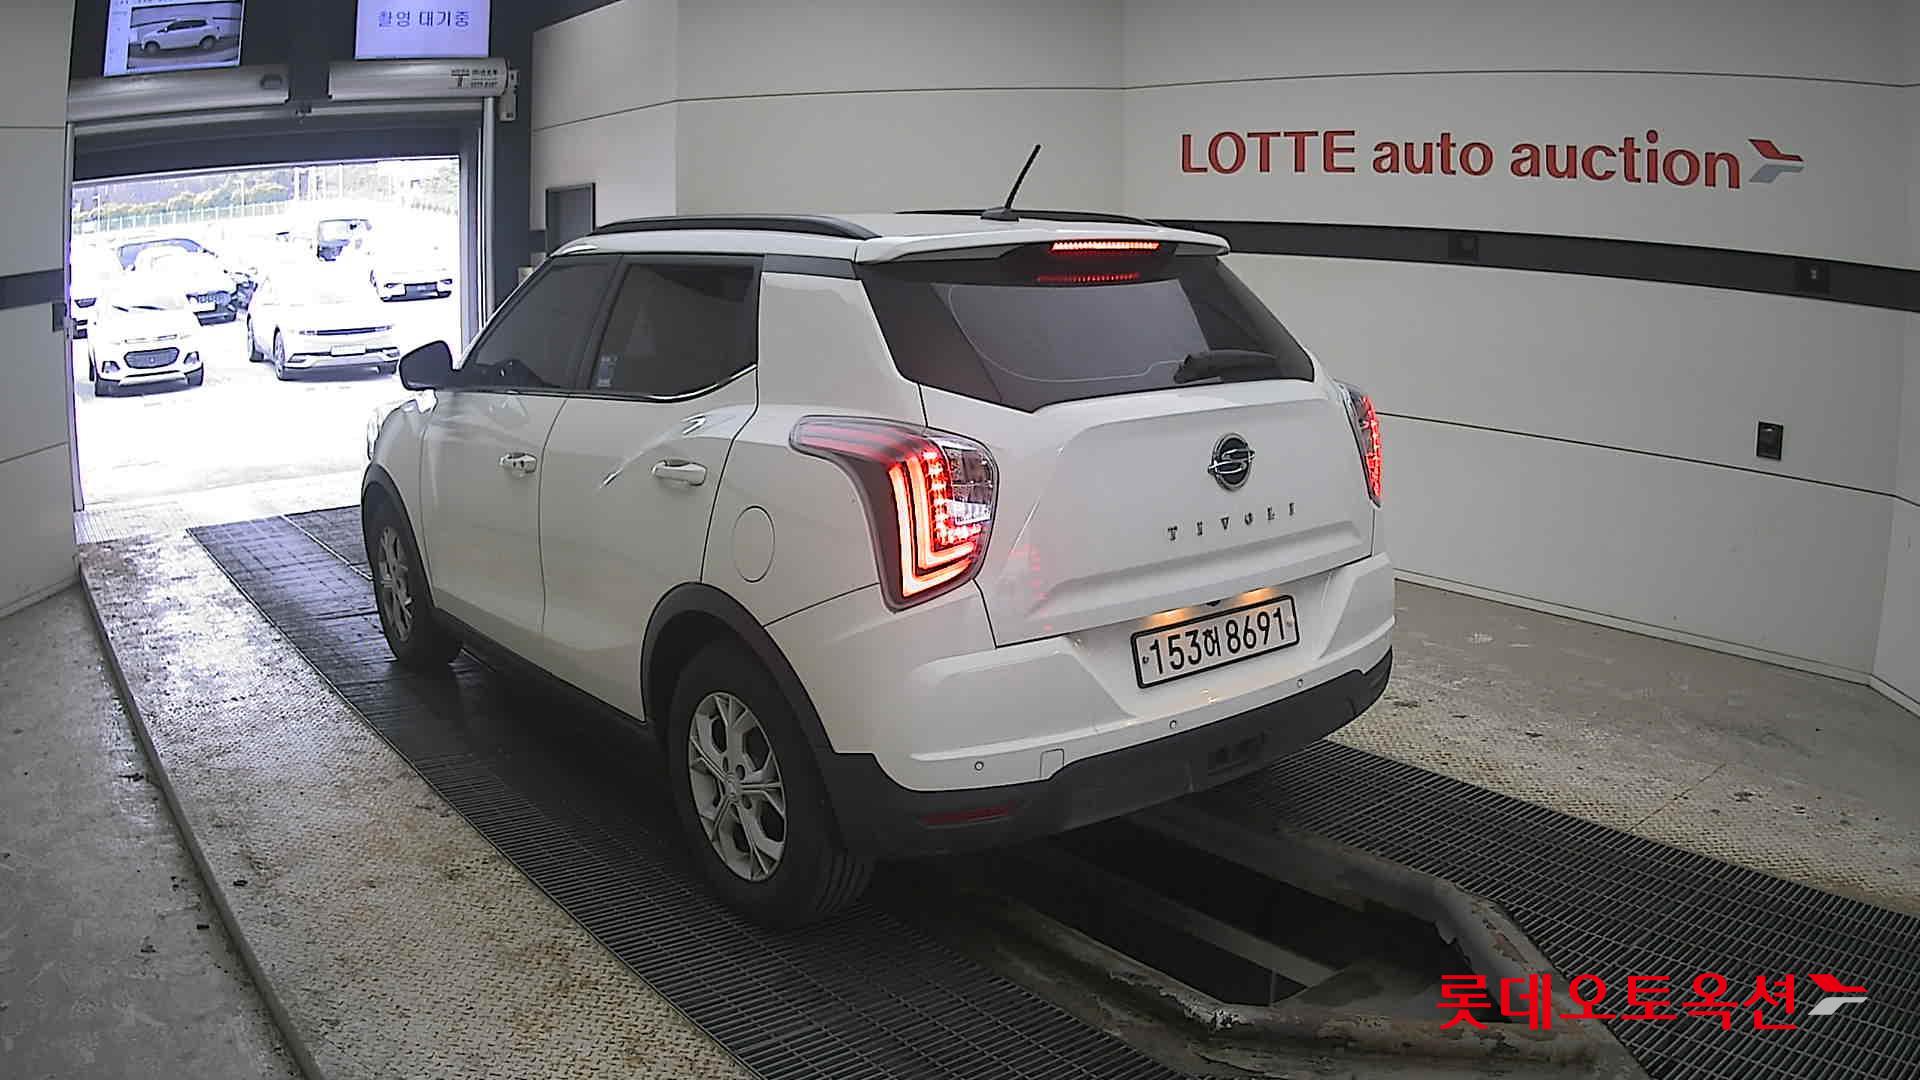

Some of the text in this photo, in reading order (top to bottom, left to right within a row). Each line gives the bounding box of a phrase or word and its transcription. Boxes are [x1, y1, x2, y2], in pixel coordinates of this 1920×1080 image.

[419, 11, 470, 27] 대기중
[1181, 129, 1741, 189] LOTTE auto auction
[1167, 502, 1295, 541] TIVOLI
